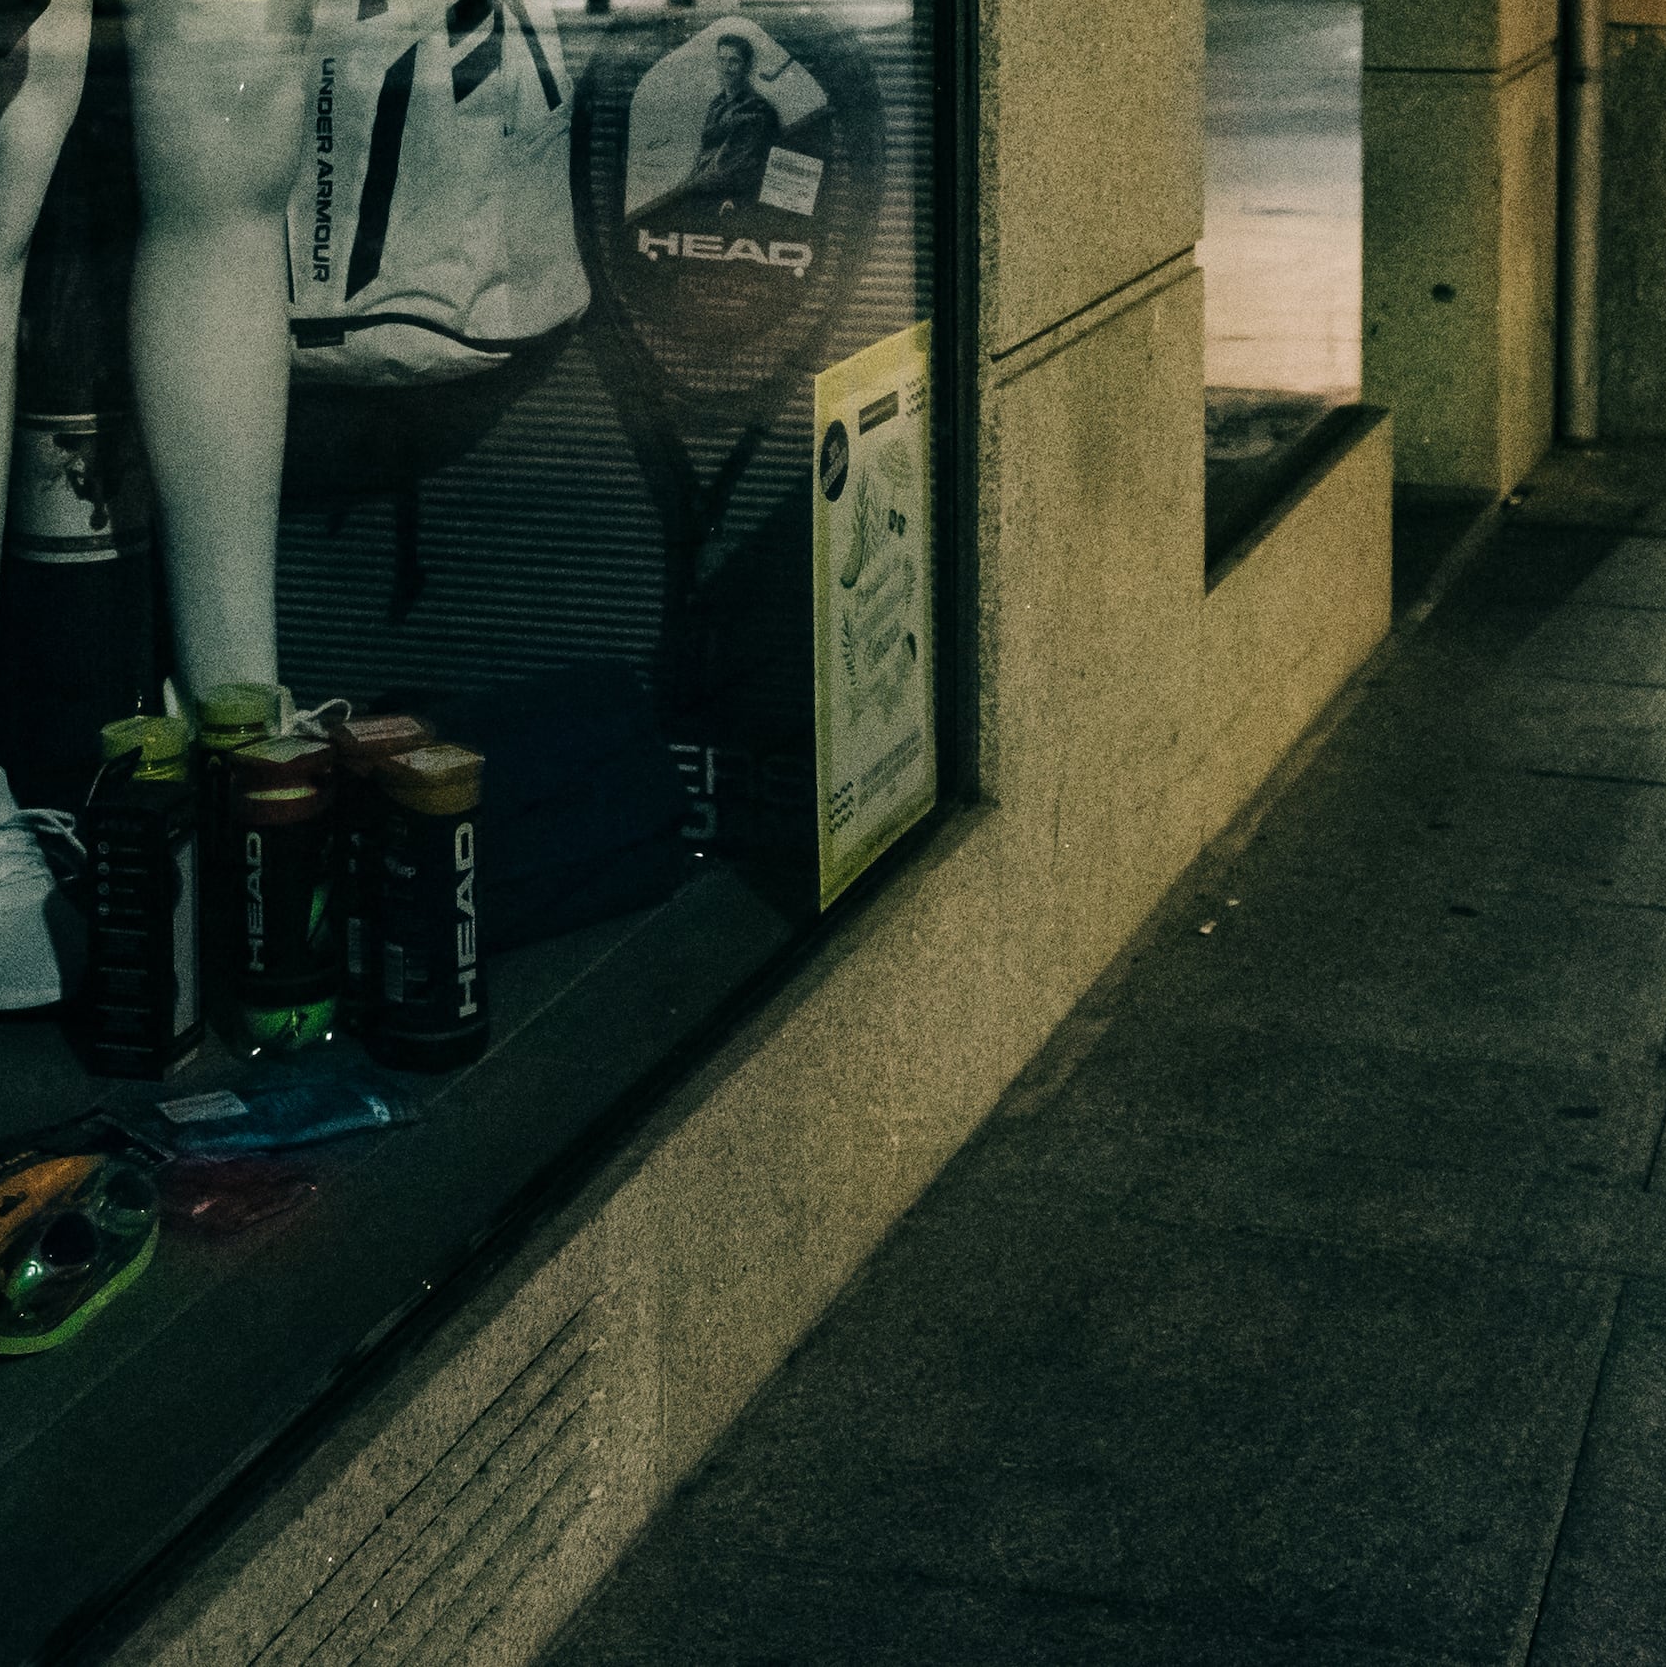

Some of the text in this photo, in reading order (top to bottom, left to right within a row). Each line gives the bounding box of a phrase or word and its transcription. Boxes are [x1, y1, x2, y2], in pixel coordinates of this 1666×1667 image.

[312, 57, 337, 283] UNDER ARMOUR
[637, 228, 814, 269] HEAD
[244, 830, 267, 974] HEAD
[455, 820, 479, 1018] HEAD
